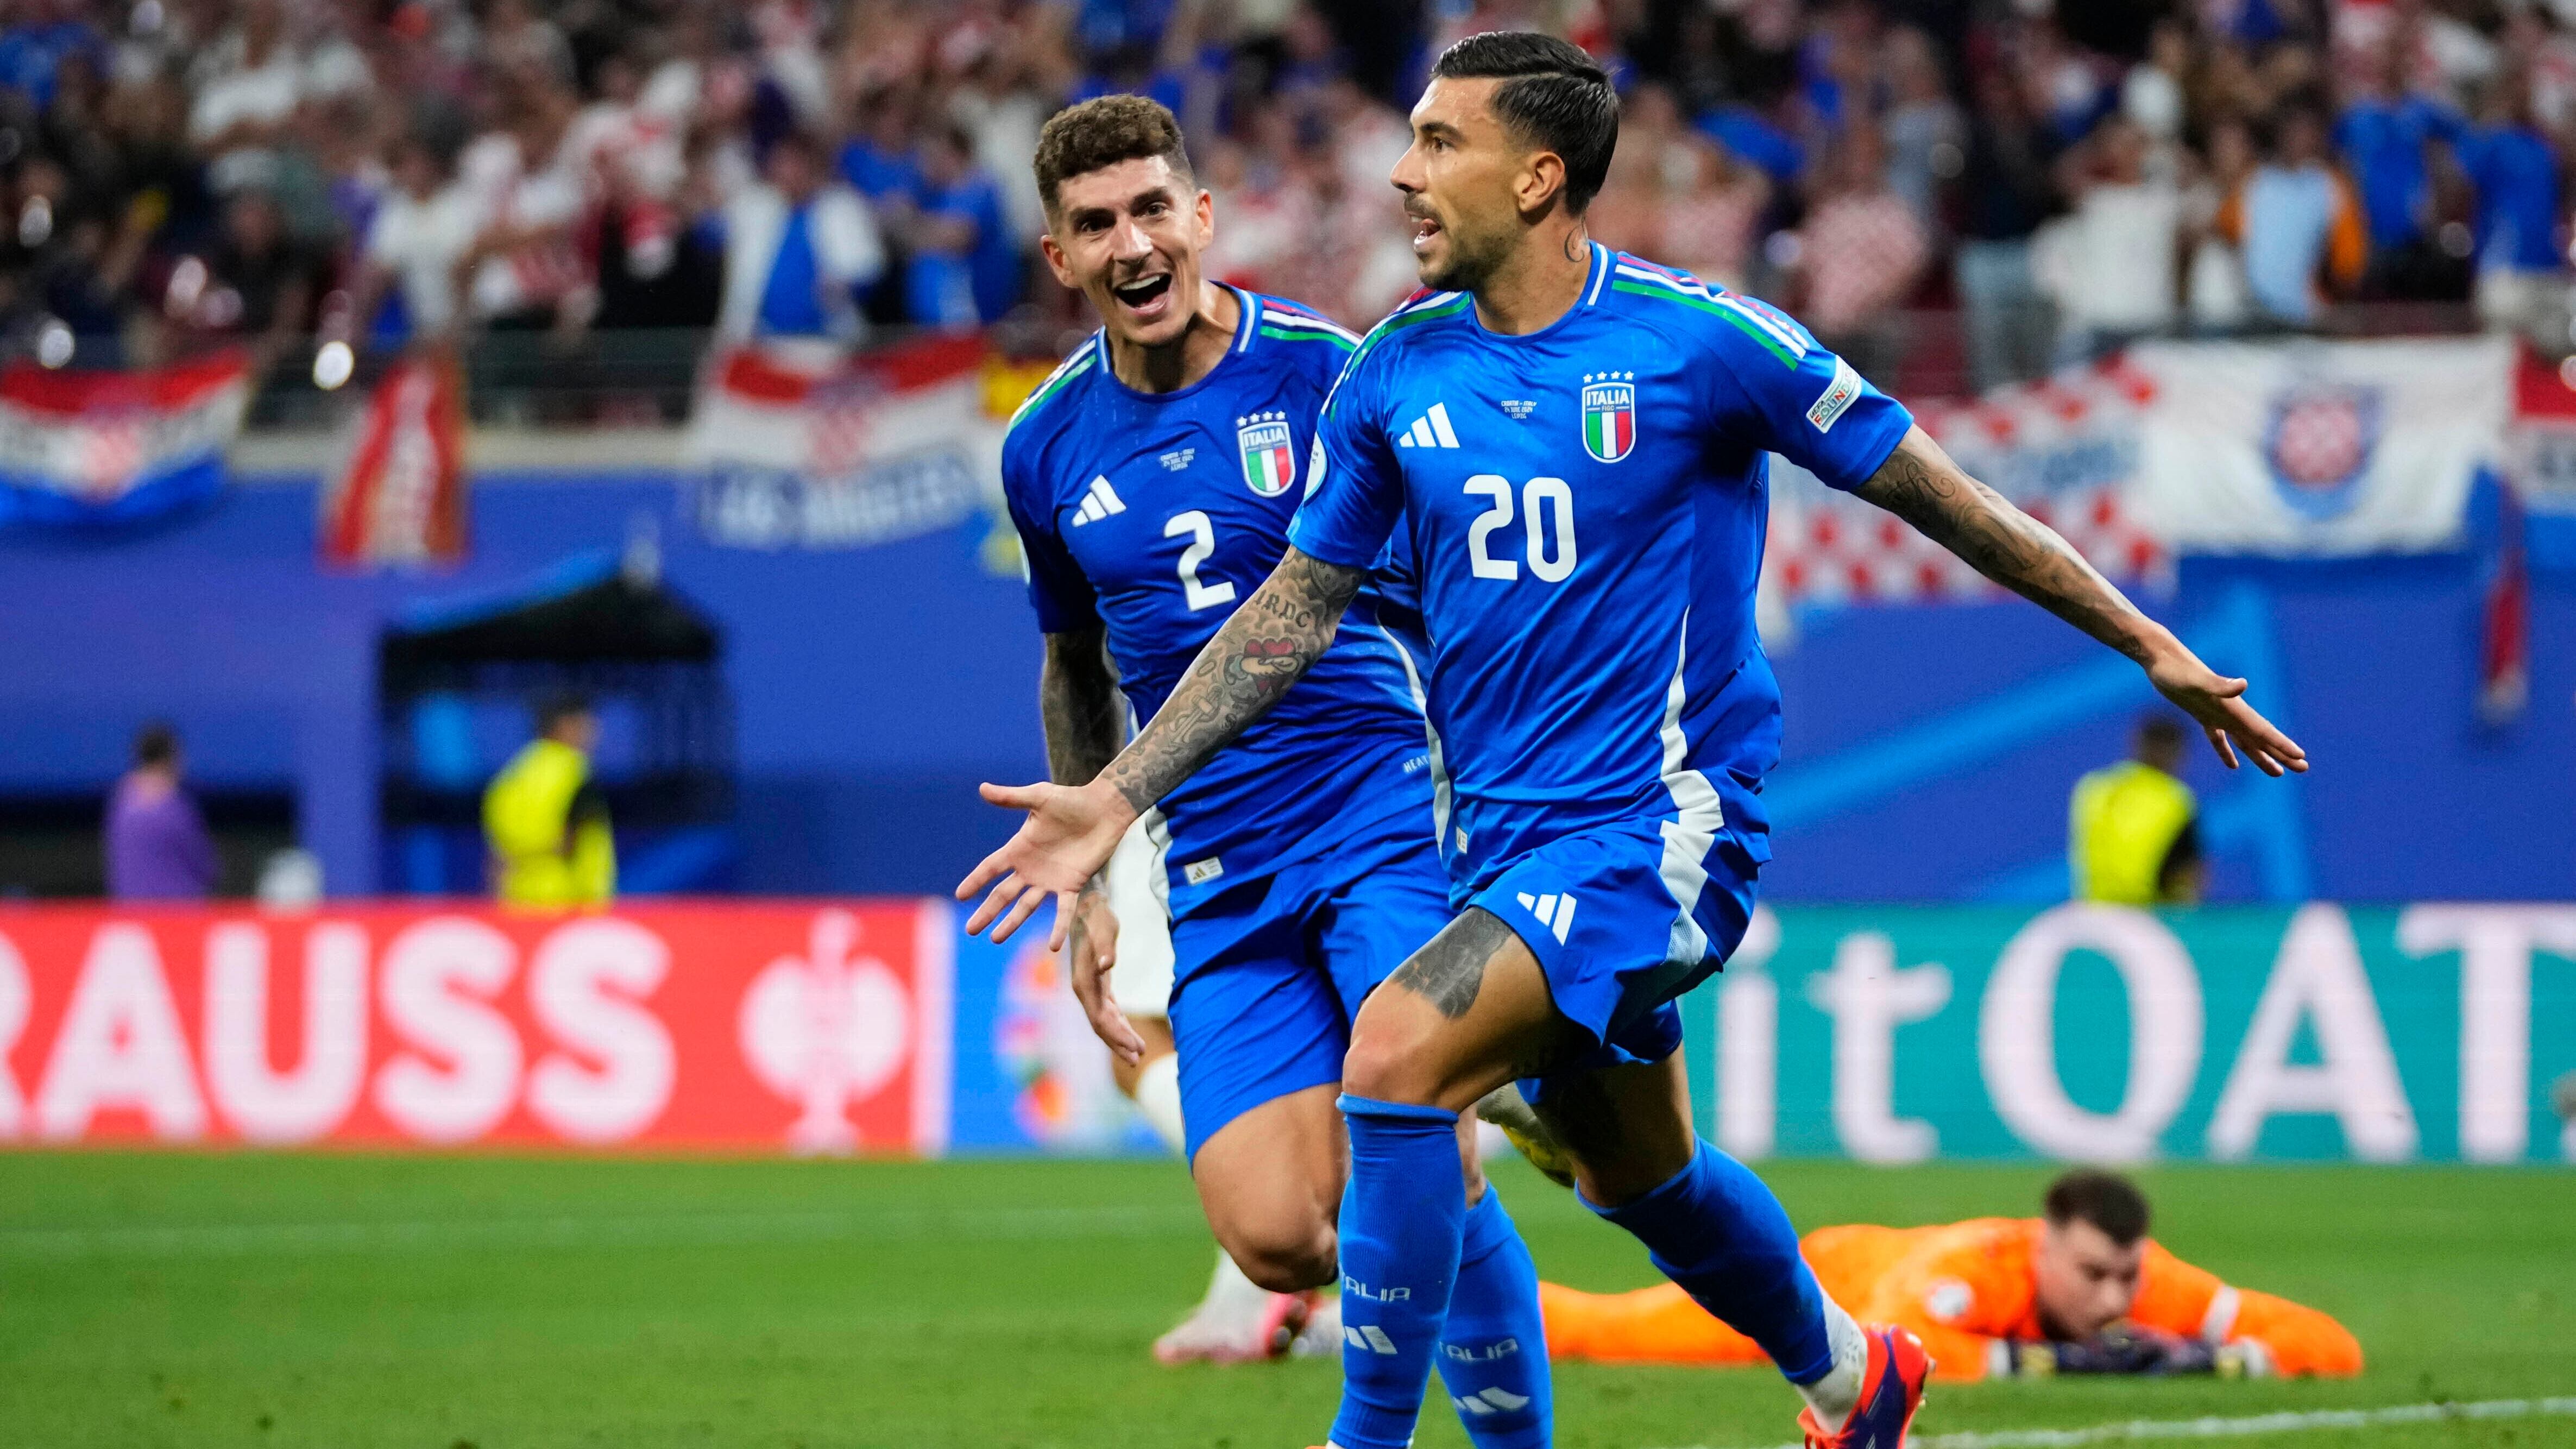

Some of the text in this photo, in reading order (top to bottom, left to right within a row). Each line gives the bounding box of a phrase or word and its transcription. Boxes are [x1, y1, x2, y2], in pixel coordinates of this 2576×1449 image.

[1586, 389, 1630, 406] ITALIA
[1810, 400, 1826, 419] UEFA
[1244, 427, 1286, 448] ITALIA
[1463, 474, 1577, 583] 20
[1163, 510, 1236, 612] 2
[0, 915, 677, 1145] AUSS
[1343, 1275, 1410, 1302] ALIA
